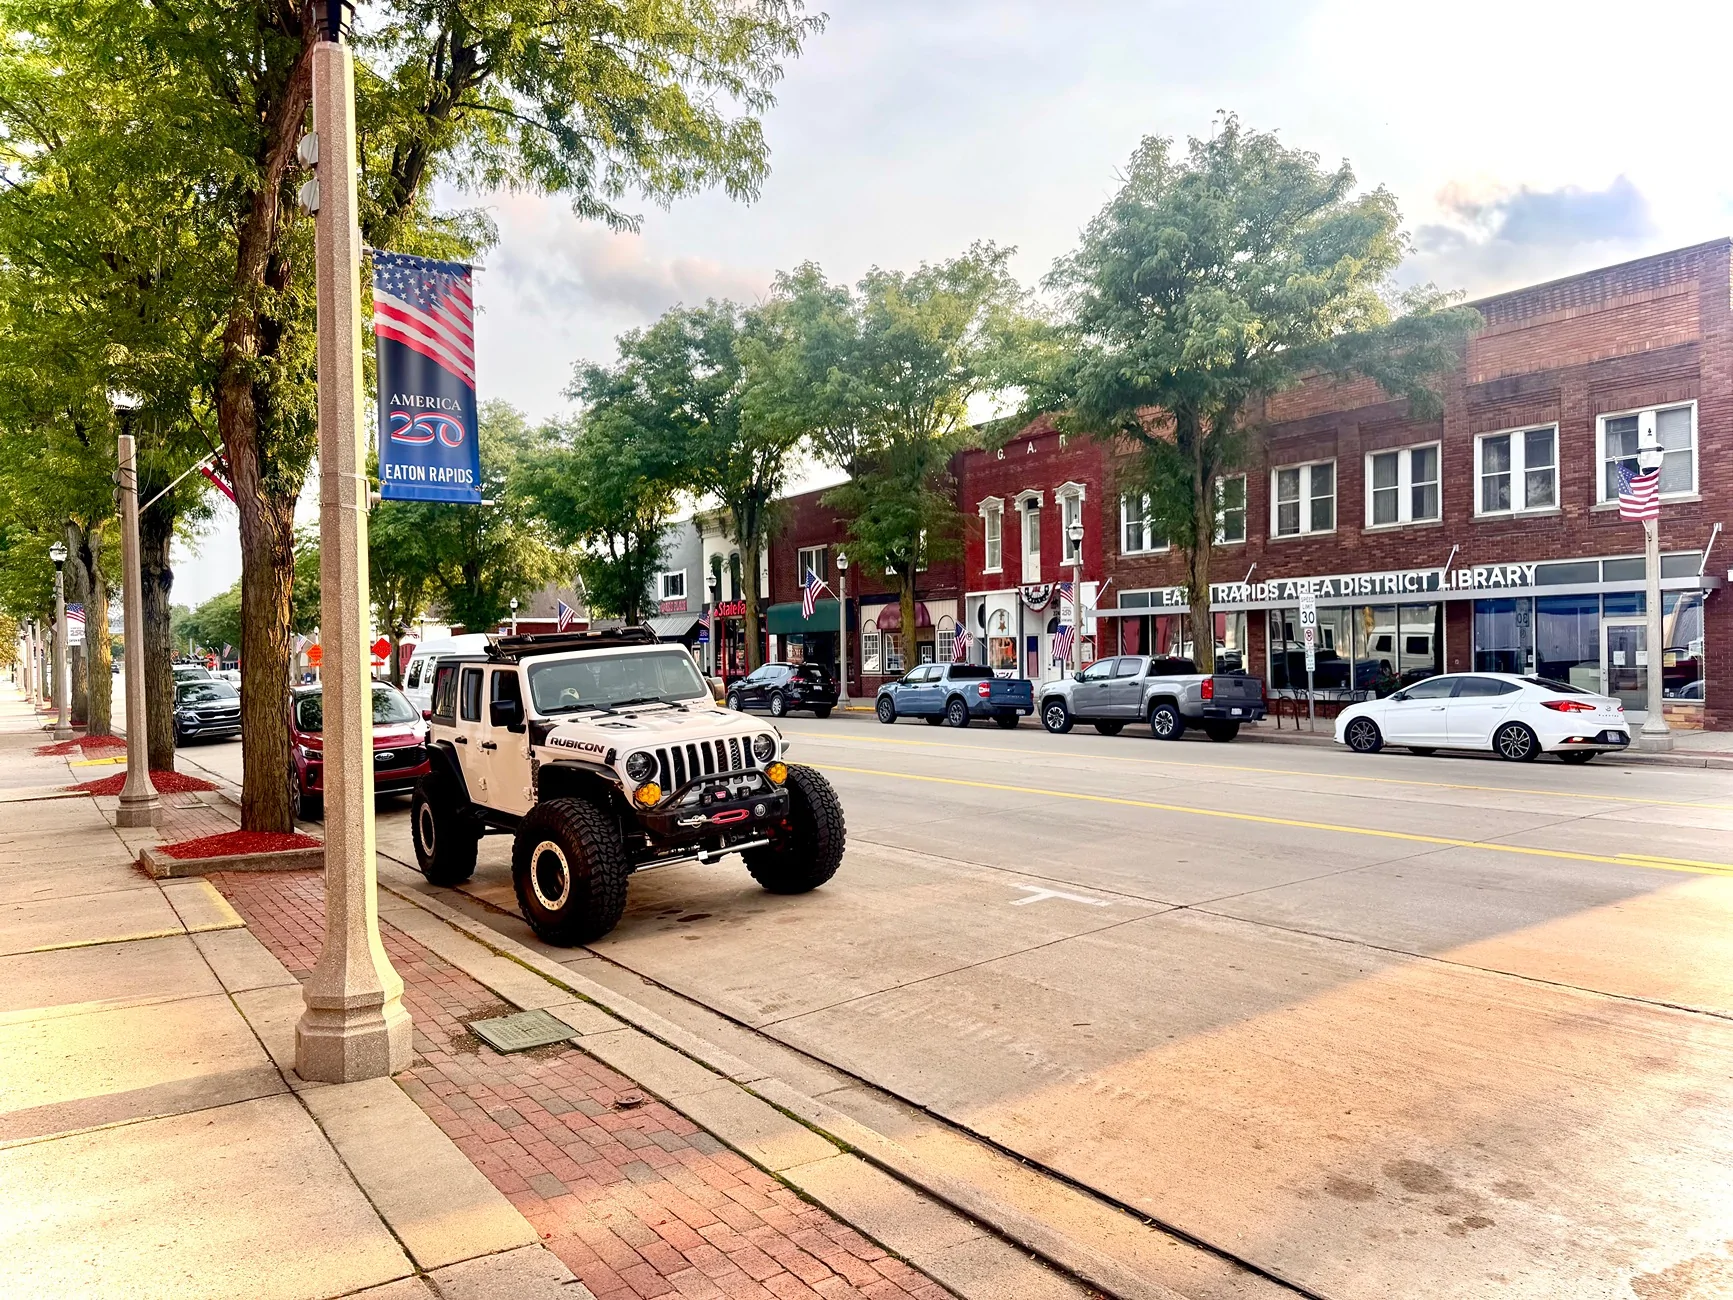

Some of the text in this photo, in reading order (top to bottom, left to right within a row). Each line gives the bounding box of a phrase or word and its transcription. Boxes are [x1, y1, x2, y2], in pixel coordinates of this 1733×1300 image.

[390, 394, 461, 411] AMERICA
[390, 411, 465, 448] 250
[385, 464, 473, 484] EATON RAPIDS
[1218, 583, 1279, 602] RAPIDS
[1283, 579, 1335, 598] AREA
[1340, 571, 1432, 594] DISTRICT
[1438, 565, 1537, 589] LIBRARY
[1302, 611, 1315, 624] 30
[550, 737, 605, 754] RUBICON
